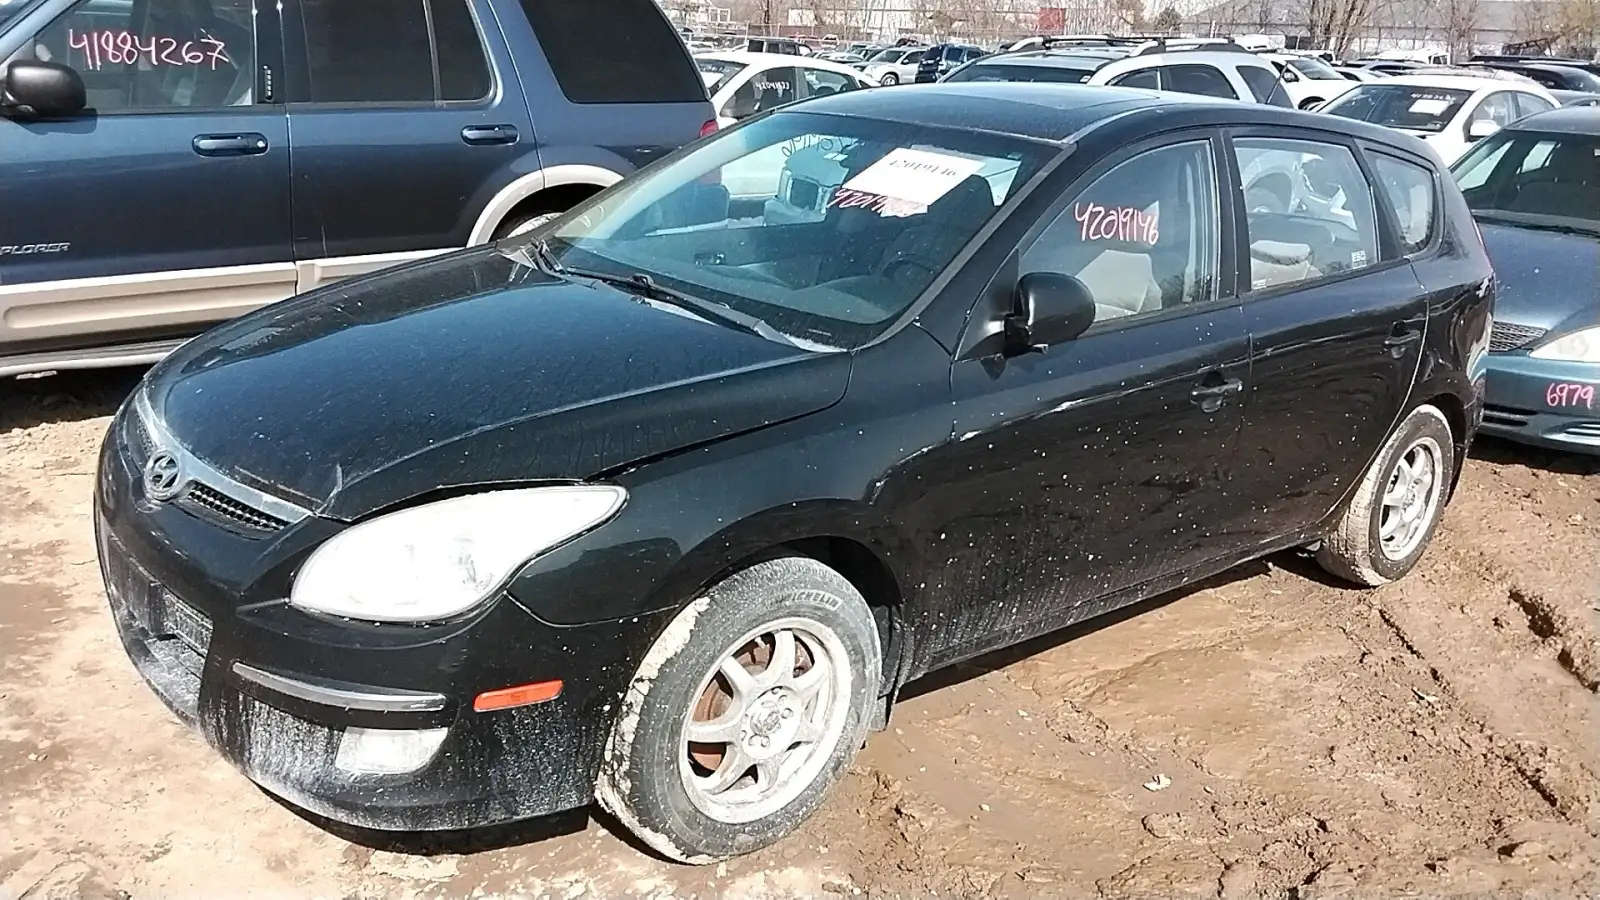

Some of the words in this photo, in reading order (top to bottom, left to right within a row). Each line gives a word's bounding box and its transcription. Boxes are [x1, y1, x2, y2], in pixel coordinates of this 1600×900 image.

[69, 28, 229, 71] 41884267
[1074, 201, 1160, 246] 42019146
[1546, 382, 1594, 410] 6979
[779, 589, 843, 611] ICHELIN
